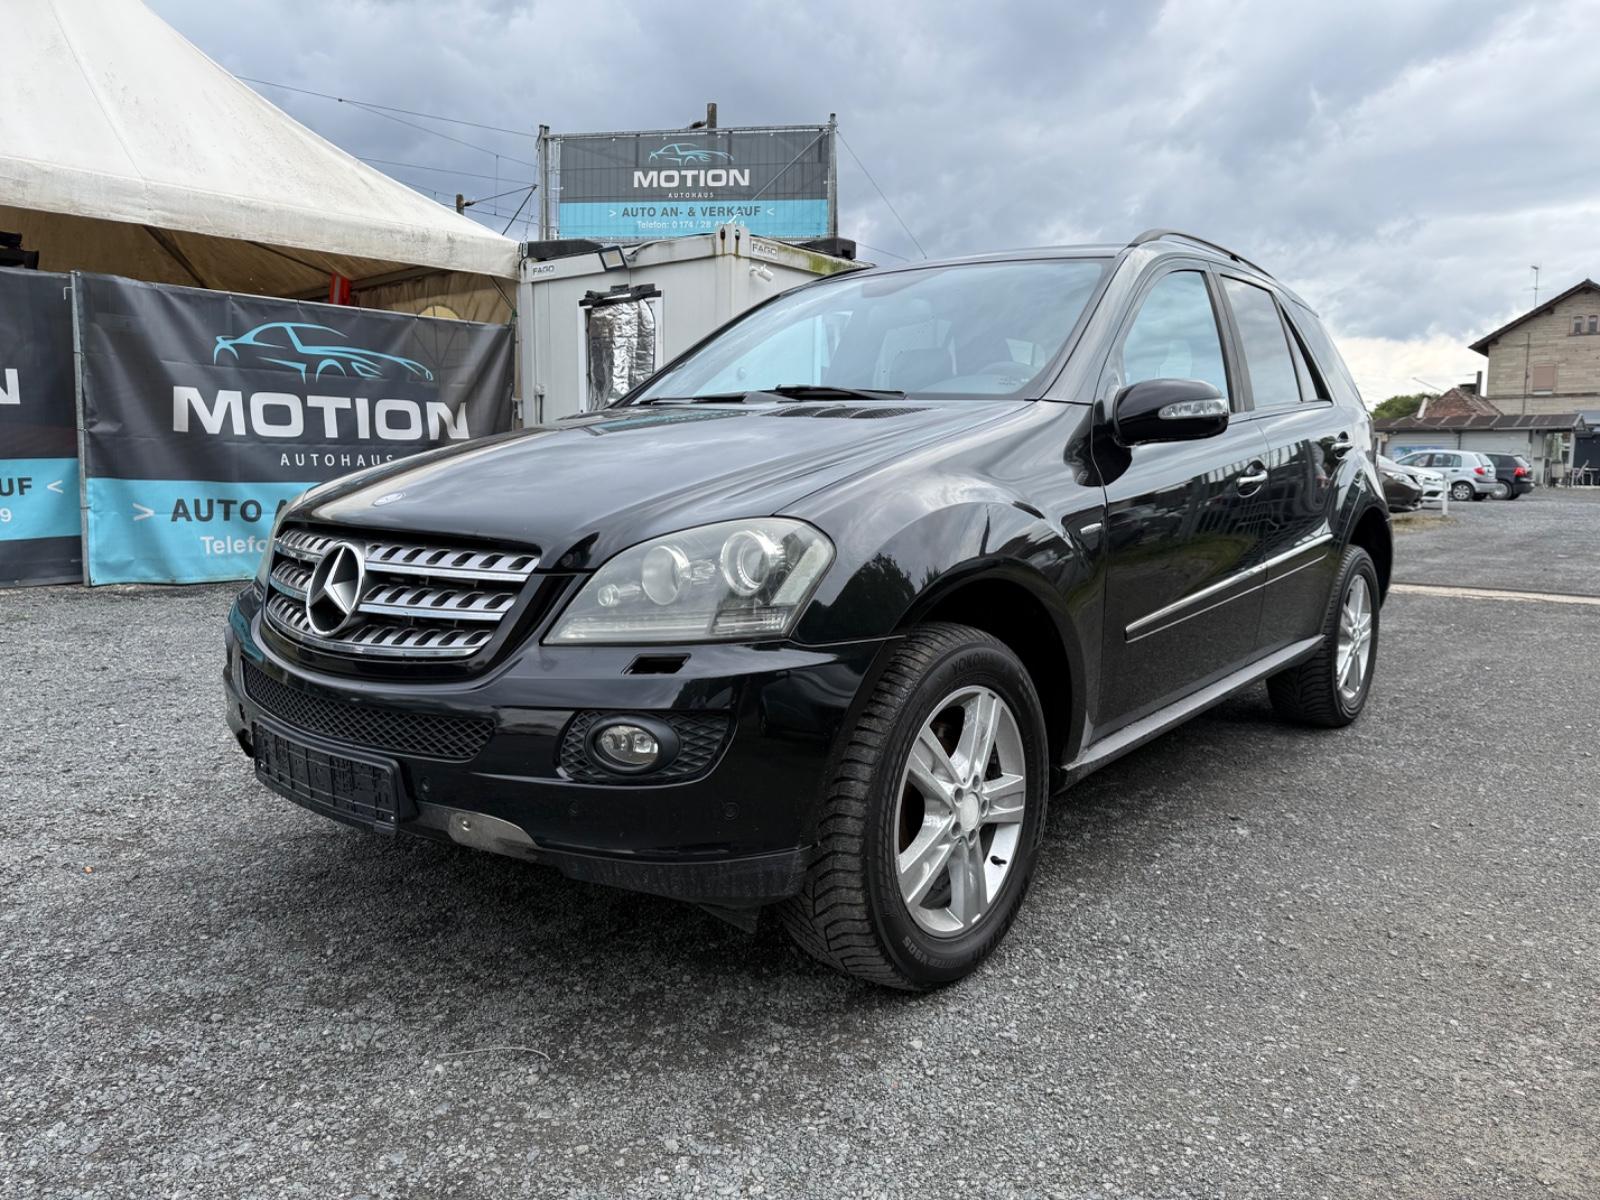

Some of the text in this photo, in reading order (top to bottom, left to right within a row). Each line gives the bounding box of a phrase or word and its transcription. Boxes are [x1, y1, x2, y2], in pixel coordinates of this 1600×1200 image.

[633, 168, 750, 188] MOTION
[622, 205, 761, 218] AUTO AN- & VERKAUF
[173, 386, 470, 440] MOTION
[171, 499, 262, 522] AUTO
